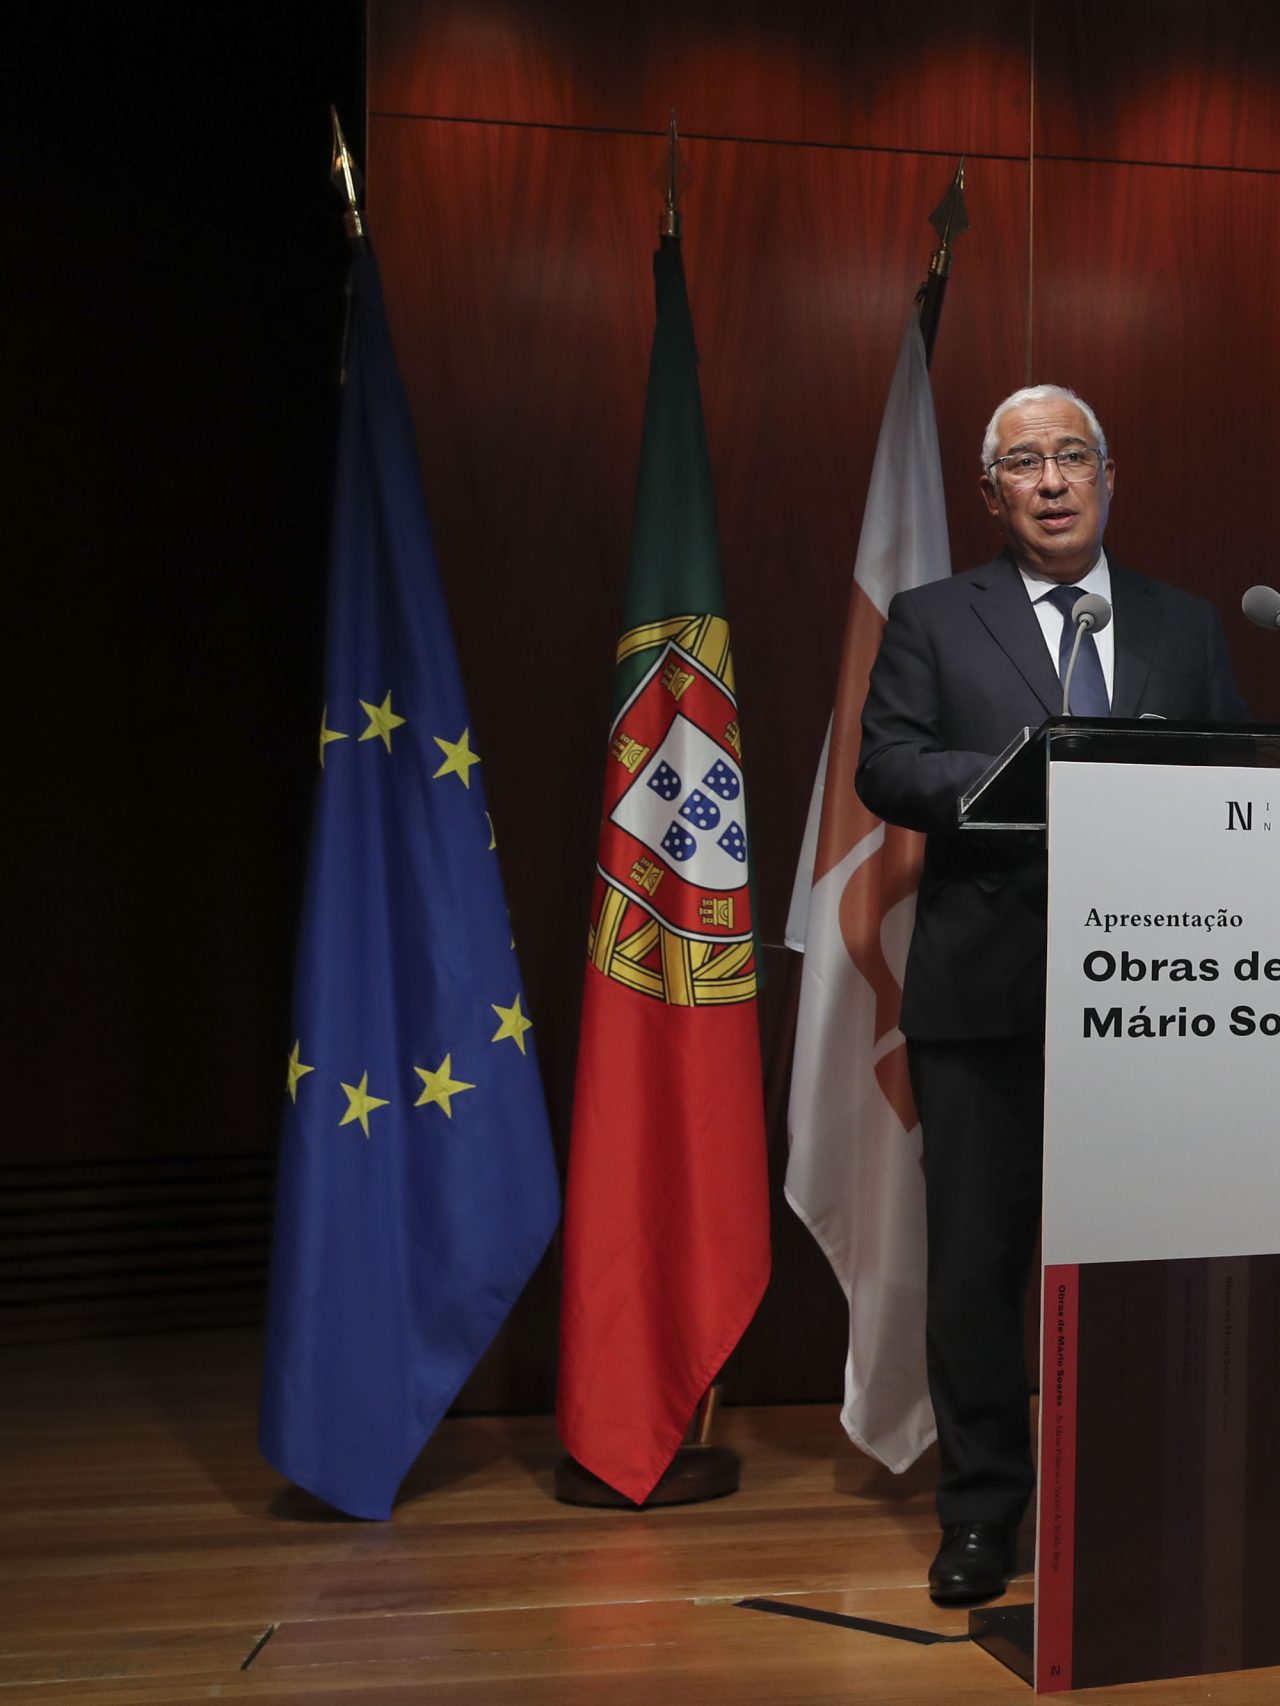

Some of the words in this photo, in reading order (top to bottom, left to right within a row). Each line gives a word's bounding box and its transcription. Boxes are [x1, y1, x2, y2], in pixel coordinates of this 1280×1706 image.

[1084, 908, 1242, 932] Apresentação
[1083, 951, 1219, 982] Obras
[1084, 1006, 1215, 1038] Mário
[1057, 1284, 1067, 1317] Obras
[1057, 1319, 1066, 1333] de
[1056, 1369, 1065, 1407] Soares
